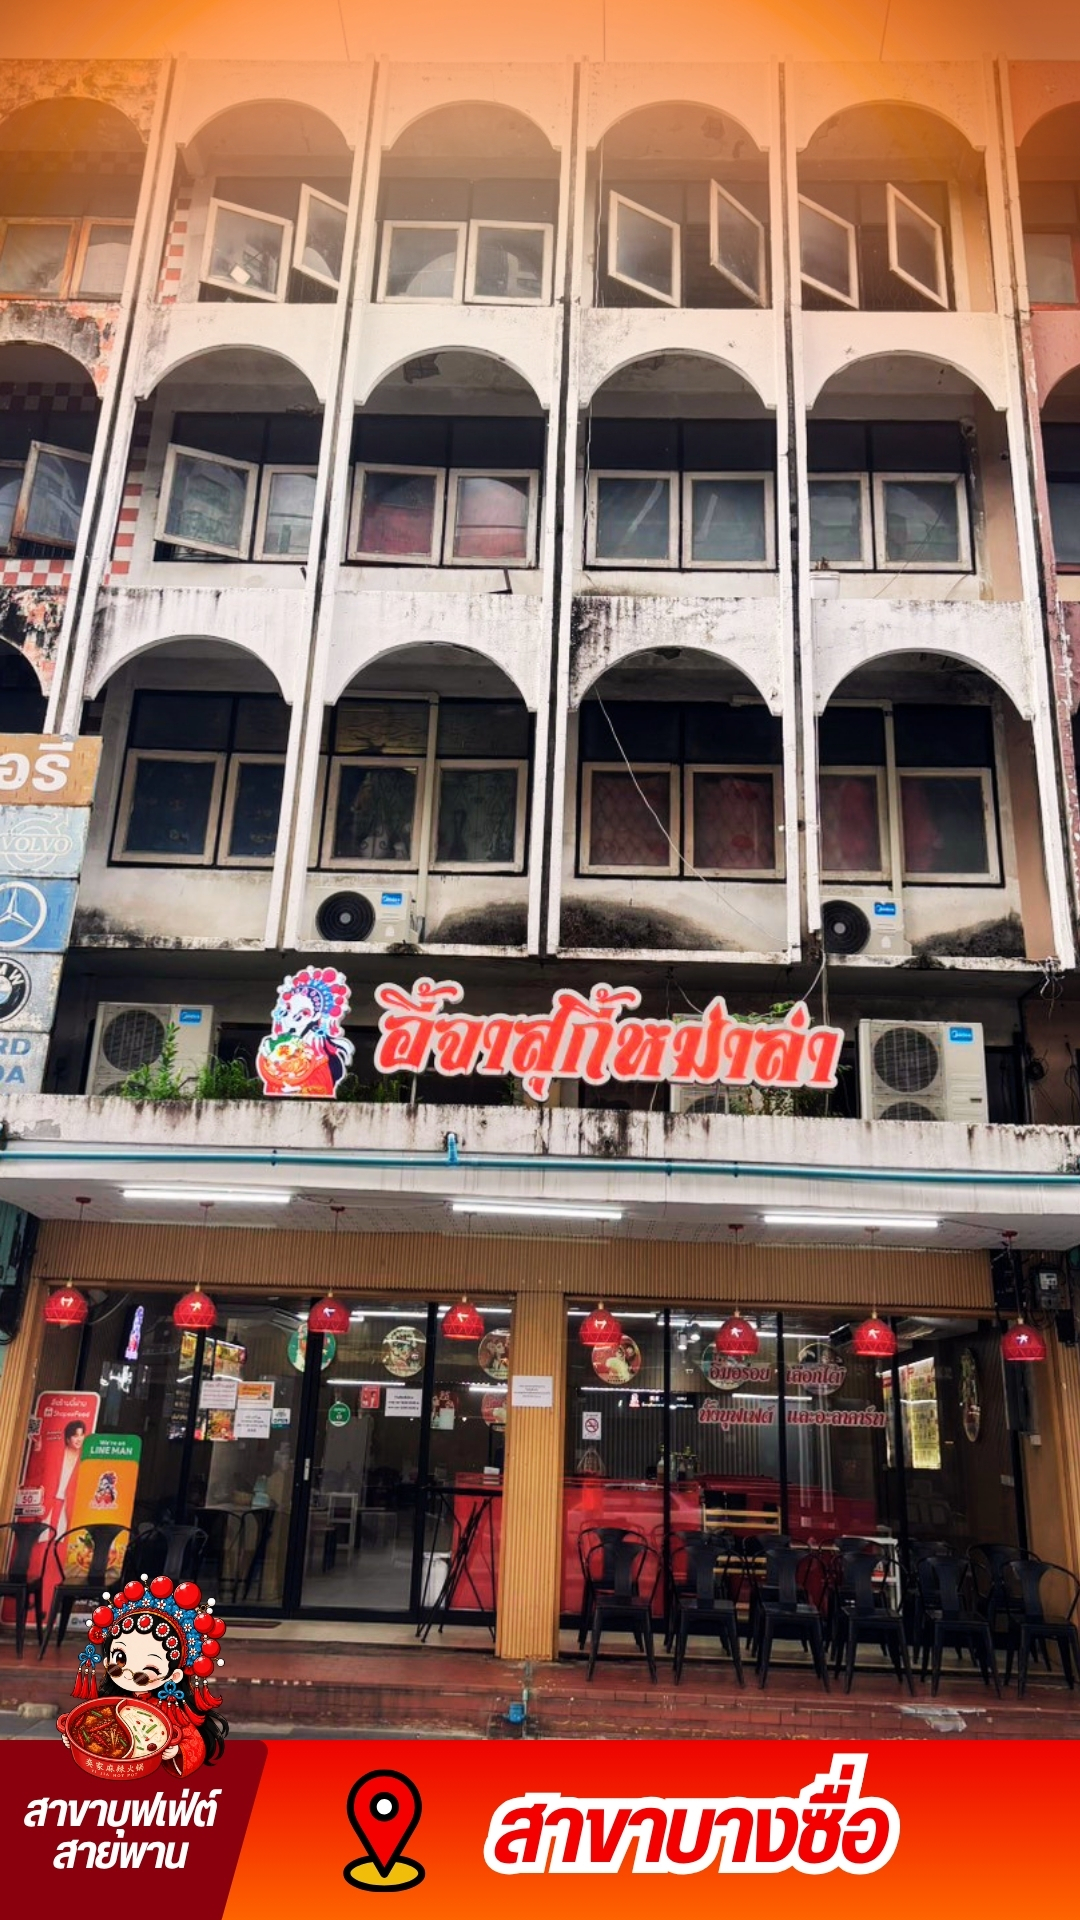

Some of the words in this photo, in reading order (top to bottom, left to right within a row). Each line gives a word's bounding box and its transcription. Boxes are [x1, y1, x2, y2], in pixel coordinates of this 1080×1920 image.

[2, 836, 69, 852] VOLVO
[377, 980, 841, 1097] อี้จาสุกี้หม่าล่า
[0, 1065, 25, 1083] A
[90, 1446, 110, 1455] LINE
[111, 1447, 133, 1455] MAN
